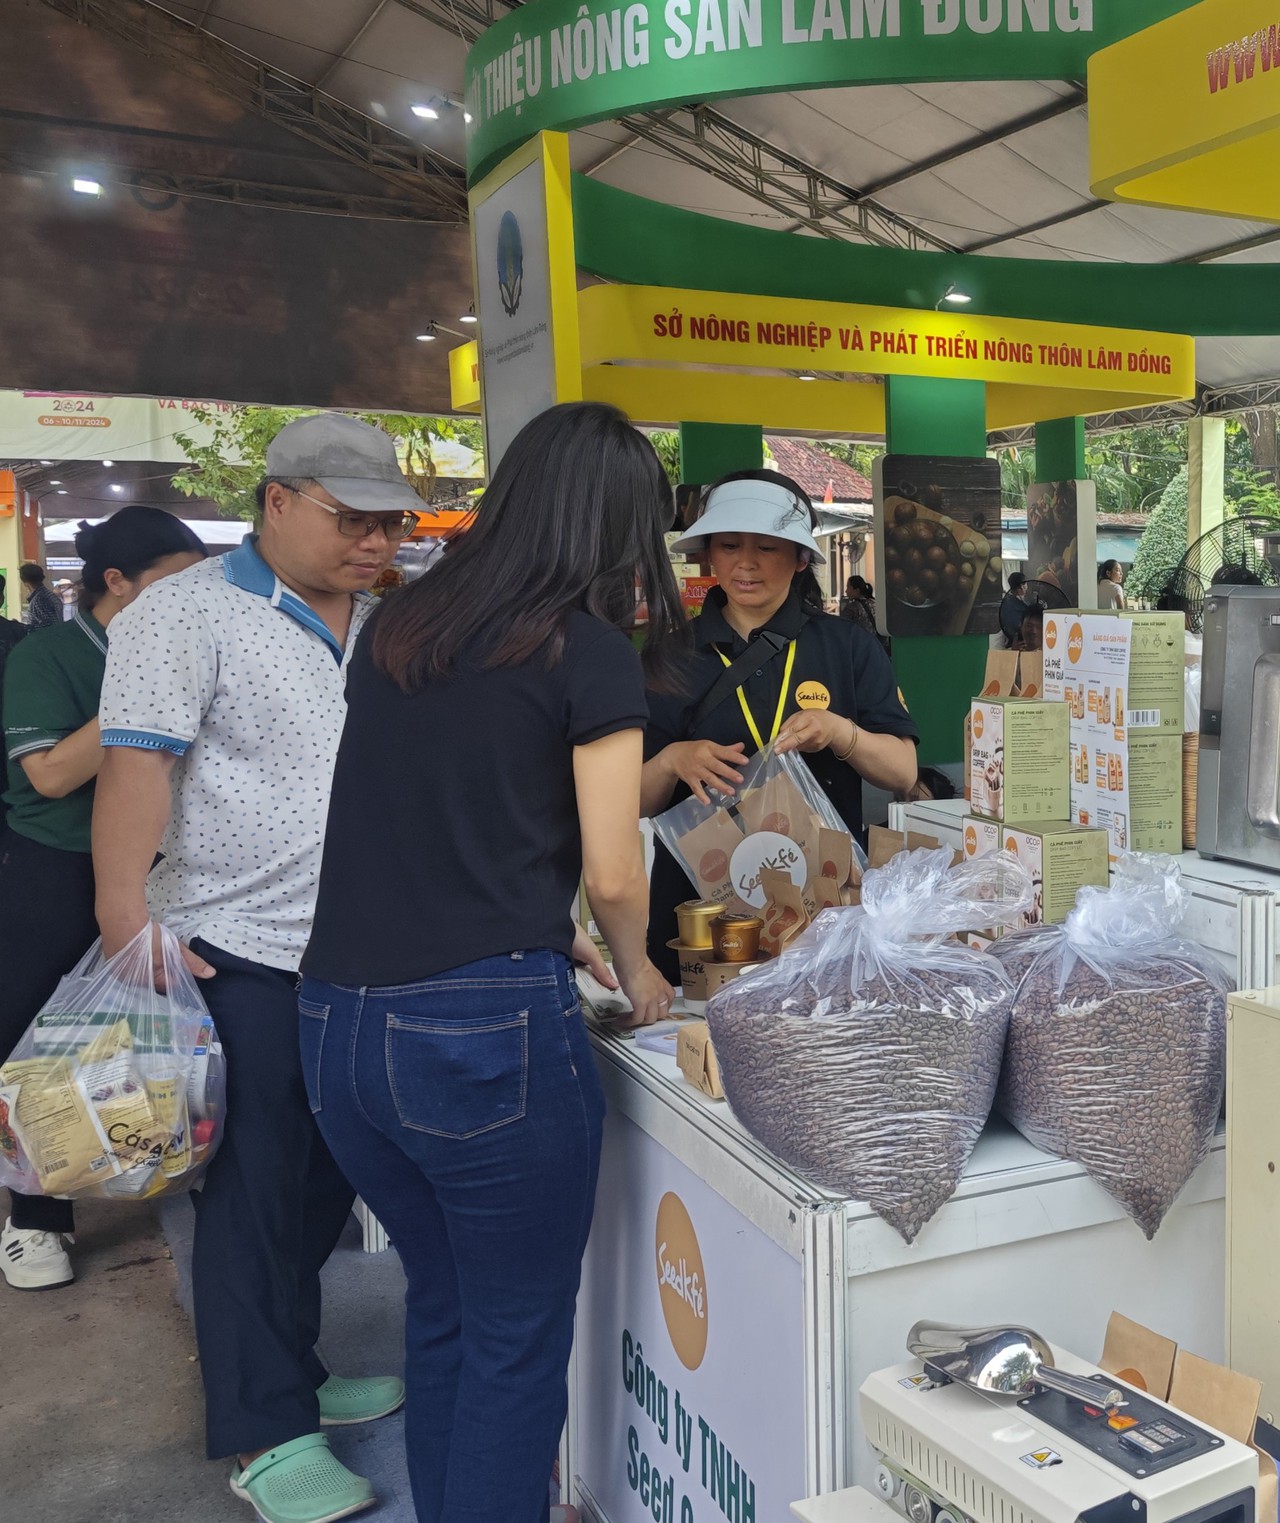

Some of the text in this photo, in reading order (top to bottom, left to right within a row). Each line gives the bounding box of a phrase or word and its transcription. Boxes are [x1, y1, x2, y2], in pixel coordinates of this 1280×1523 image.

[484, 32, 541, 120] THIỆU
[551, 4, 649, 88] NÔNG
[653, 307, 1171, 375] SỞ NÔNG NGHIỆP VÀ PHÁT TRIỂN NÔNG THÔN LÂM ĐỒNG
[43, 417, 54, 425] 06
[62, 418, 105, 426] 10/11/2024
[658, 1241, 704, 1319] Seedkfé
[622, 1328, 756, 1523] Công ty TNHH
[628, 1424, 674, 1523] Seed
